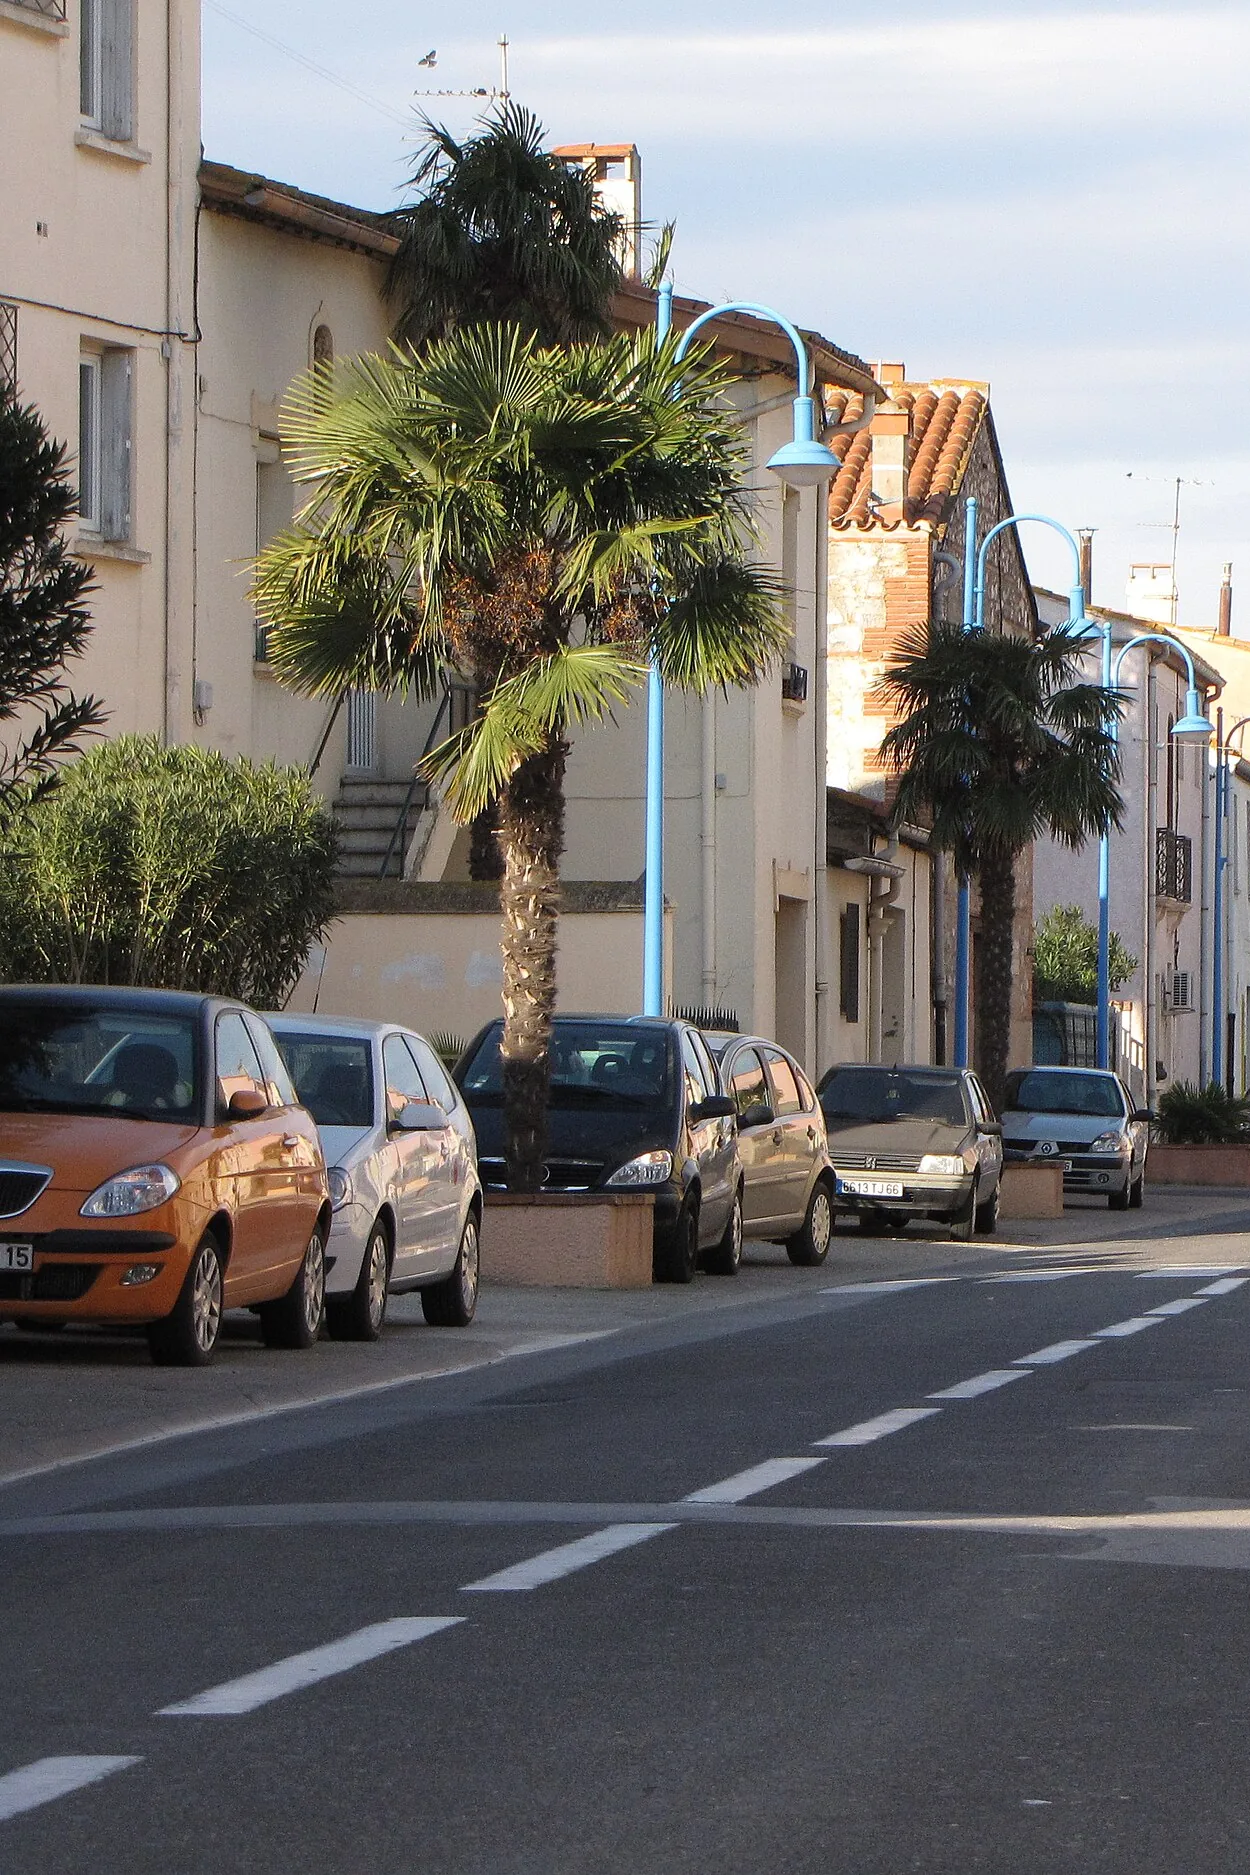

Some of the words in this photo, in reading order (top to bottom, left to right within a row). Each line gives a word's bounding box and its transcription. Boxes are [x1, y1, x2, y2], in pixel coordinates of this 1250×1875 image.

[843, 1181, 868, 1193] 6613
[872, 1183, 884, 1194] TJ
[886, 1184, 899, 1195] 66
[6, 1246, 29, 1267] 15
